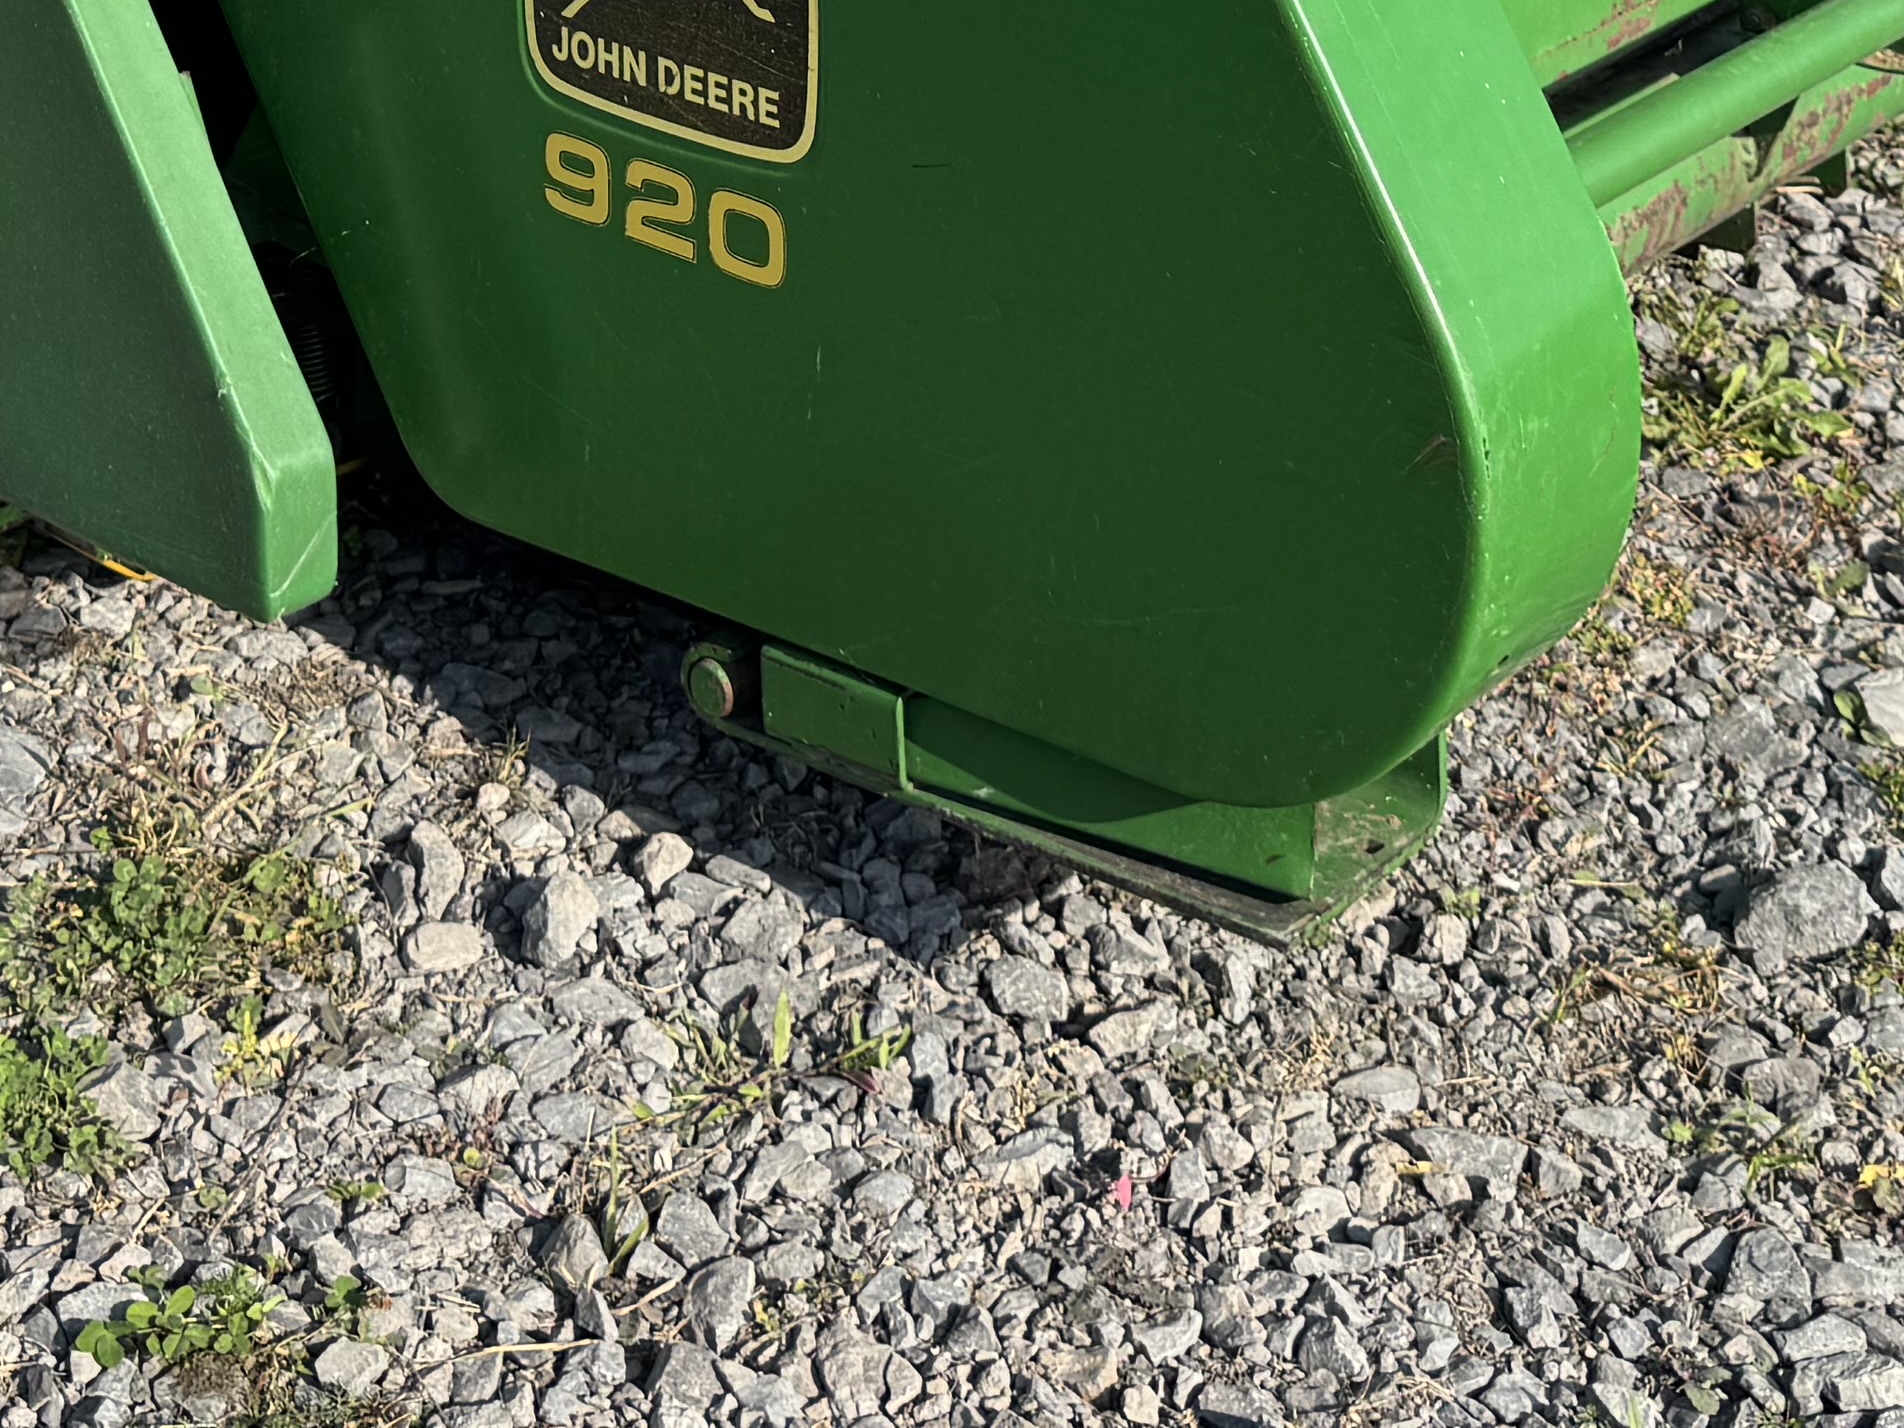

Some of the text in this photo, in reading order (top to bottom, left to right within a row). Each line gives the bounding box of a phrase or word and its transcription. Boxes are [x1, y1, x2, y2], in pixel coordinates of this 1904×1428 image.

[552, 26, 781, 128] JOHN DEERE
[544, 130, 788, 289] 920
